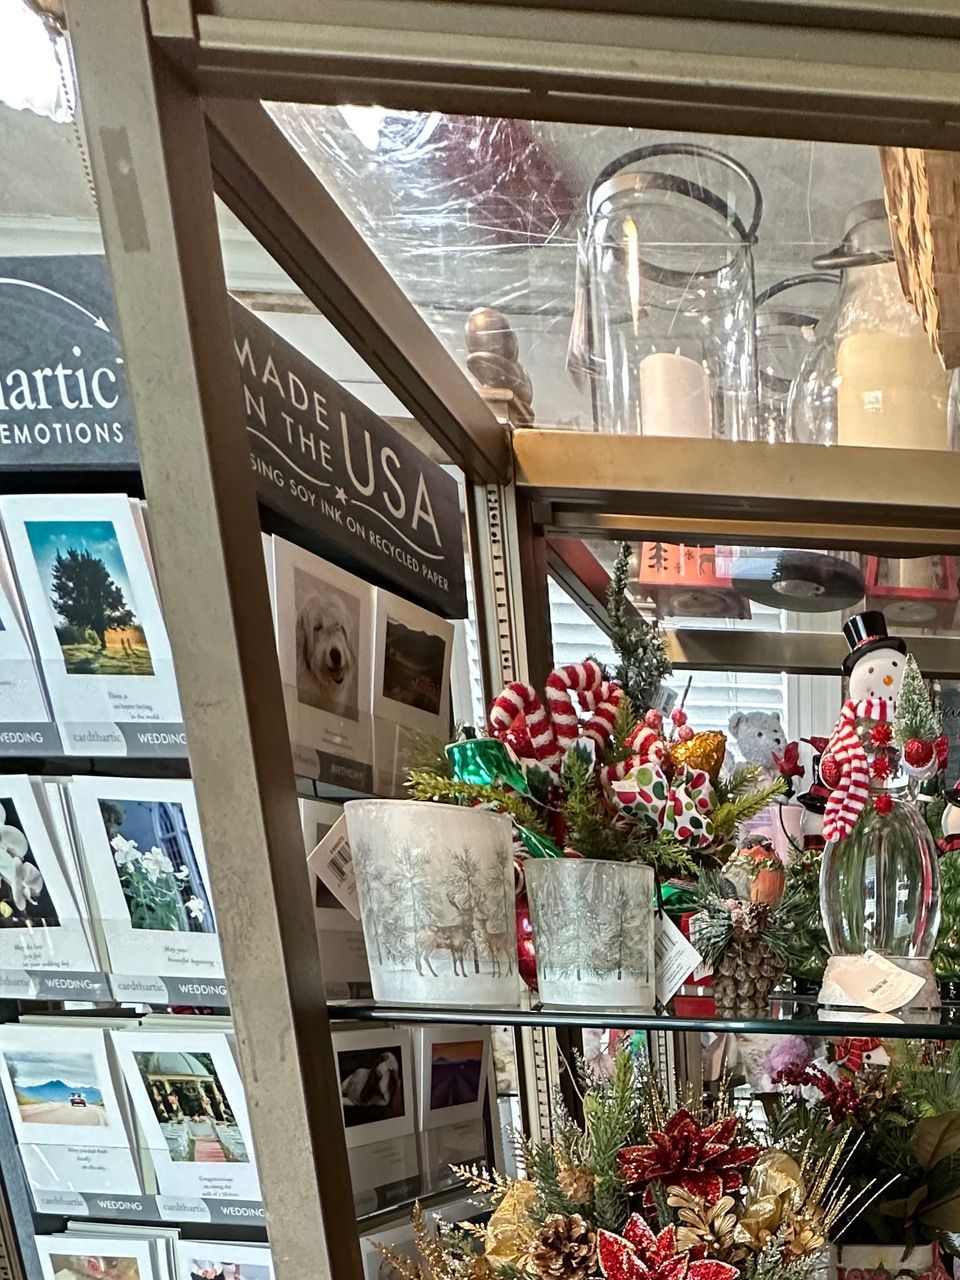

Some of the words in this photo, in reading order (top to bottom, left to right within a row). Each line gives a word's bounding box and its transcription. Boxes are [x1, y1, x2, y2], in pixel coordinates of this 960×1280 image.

[0, 422, 124, 444] EMOTIONS
[281, 412, 334, 472] THE
[340, 412, 442, 548] USA
[290, 485, 316, 507] SOY
[321, 502, 342, 526] INK
[346, 516, 366, 540] ON
[369, 531, 420, 574] RECYCLED
[422, 564, 449, 592] PAPER
[73, 730, 122, 745] cardthartic
[45, 978, 93, 990] WEDDING
[117, 980, 165, 993] cardthartic
[179, 984, 227, 996] WEDDING
[98, 1200, 143, 1211] WEDDING
